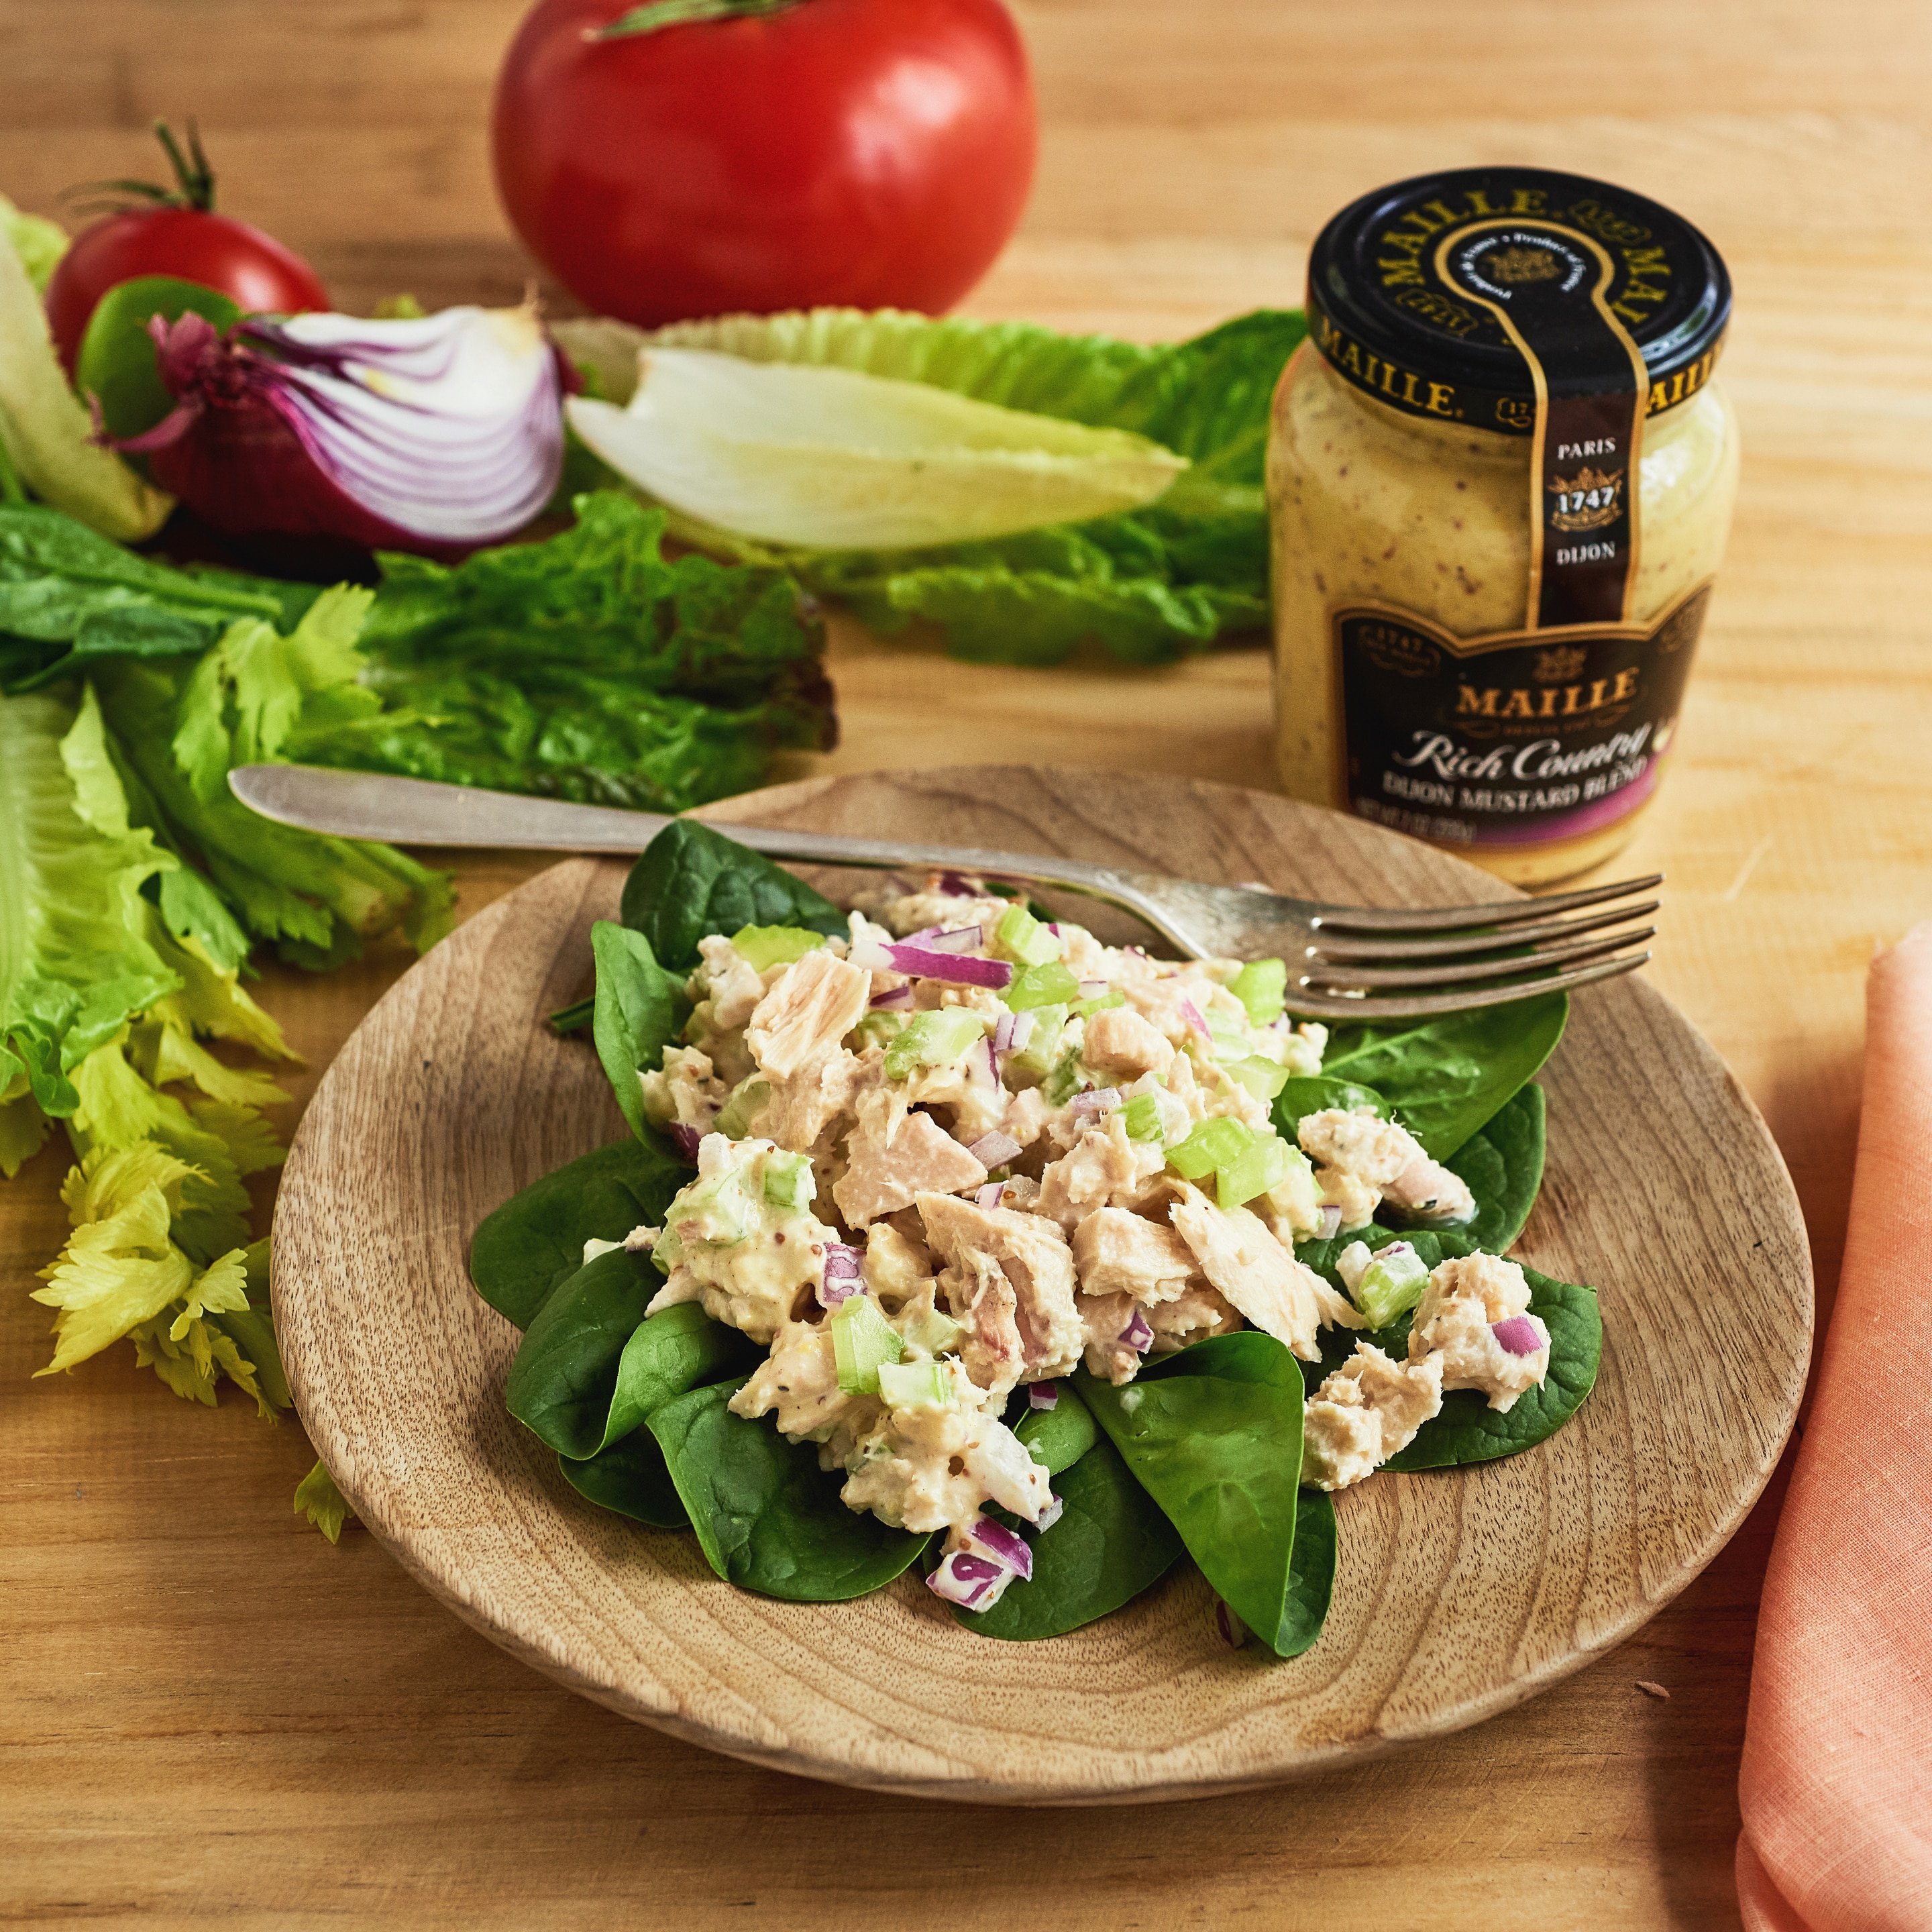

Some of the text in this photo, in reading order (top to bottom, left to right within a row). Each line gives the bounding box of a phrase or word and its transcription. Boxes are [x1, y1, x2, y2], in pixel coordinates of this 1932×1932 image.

[1557, 437, 1616, 460] PARIS
[1558, 486, 1615, 514] 1747
[1556, 541, 1615, 566] DIJON
[1455, 666, 1640, 718] MAILLE
[1392, 730, 1515, 782] Rich
[1382, 769, 1456, 808] DIJON
[1458, 782, 1580, 813] MUSTARD
